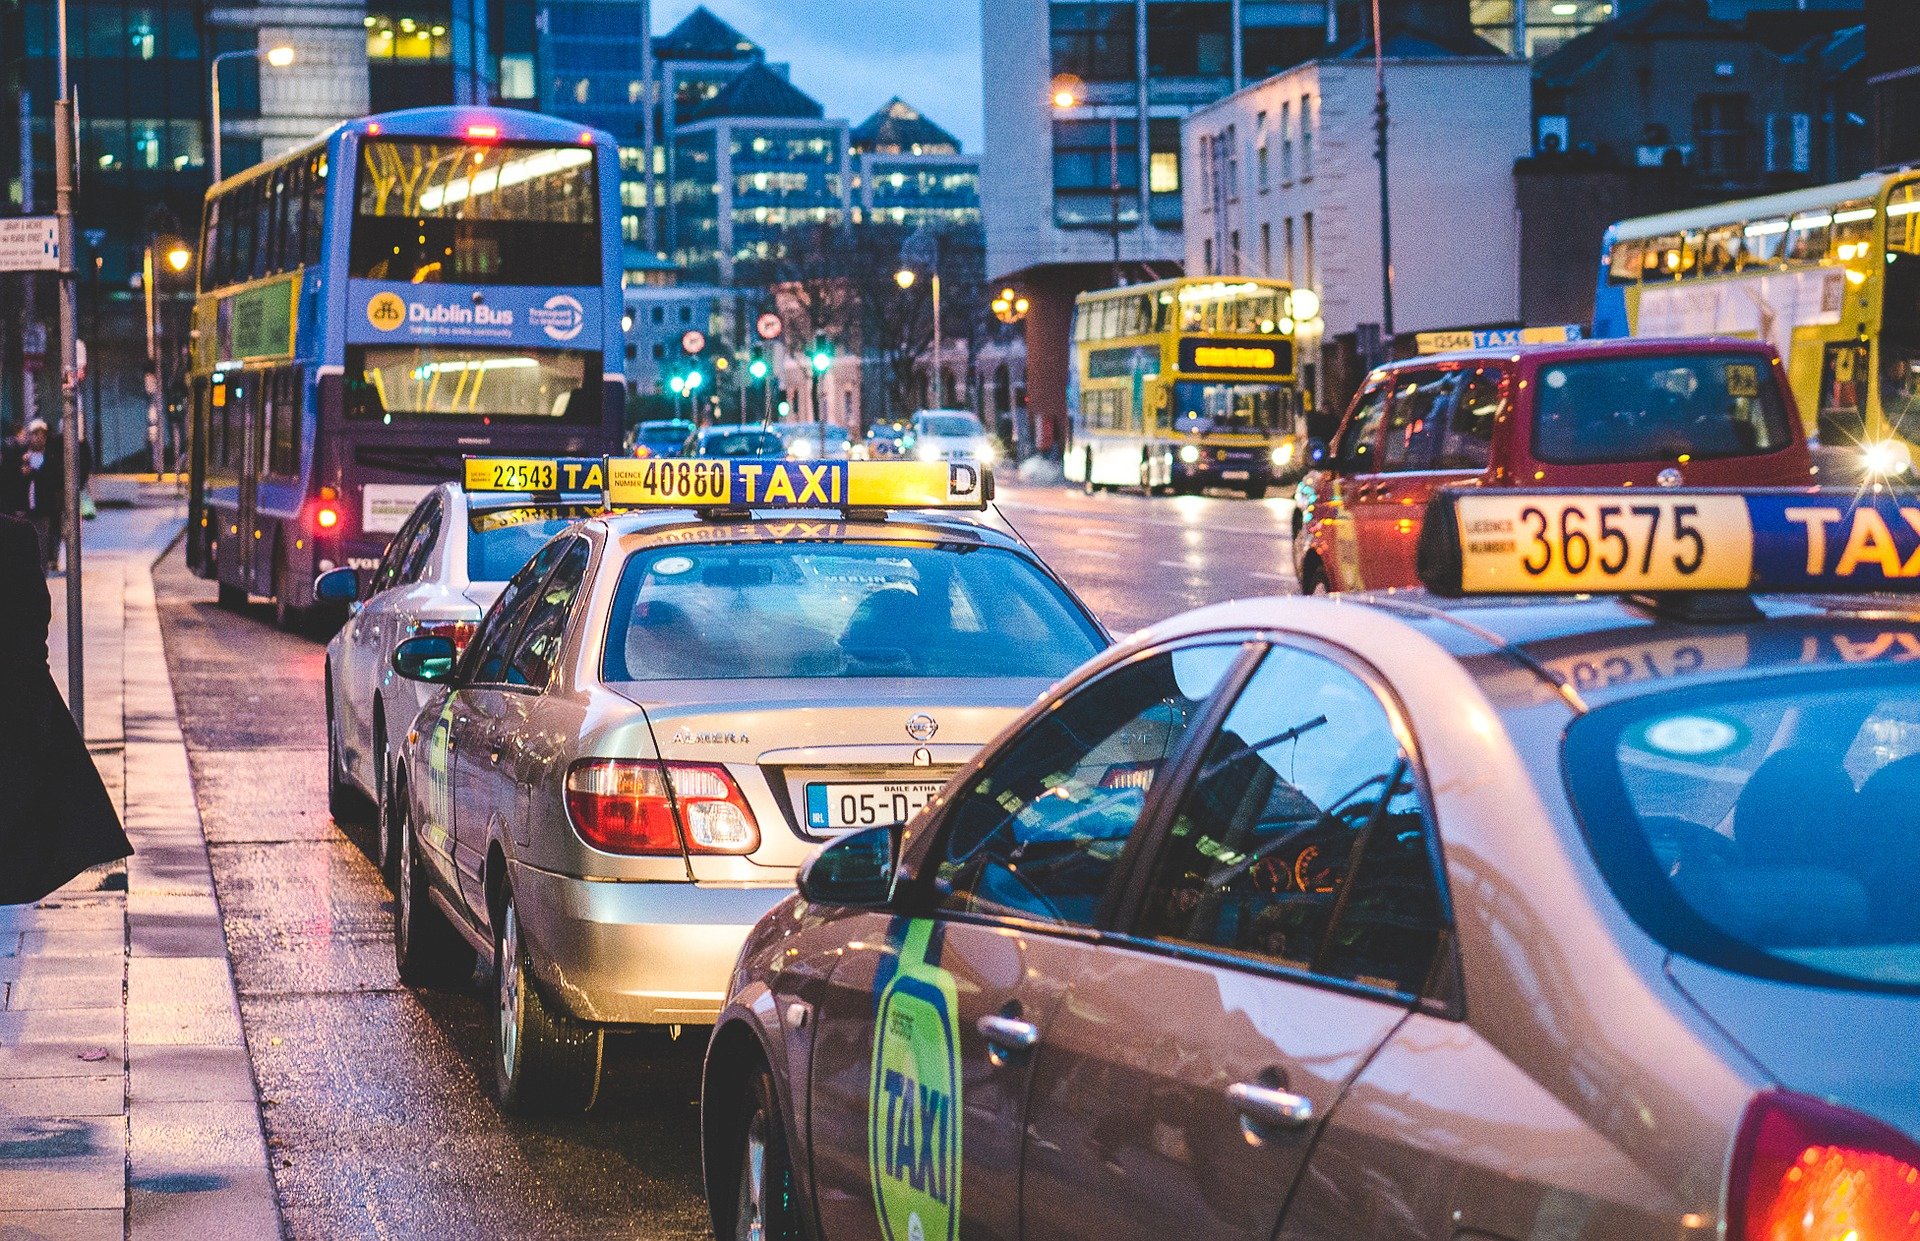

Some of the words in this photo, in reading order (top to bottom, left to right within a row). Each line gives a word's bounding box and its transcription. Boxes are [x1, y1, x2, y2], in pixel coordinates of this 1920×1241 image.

[409, 303, 472, 322] Dublin
[474, 304, 513, 325] Bus
[493, 465, 552, 489] 22543
[643, 462, 724, 498] 40880
[738, 465, 841, 504] TAXI
[949, 463, 978, 496] D
[1520, 506, 1705, 576] 36575
[673, 730, 750, 744] ALMERA
[841, 793, 935, 825] 05-D-
[884, 1068, 949, 1207] TAXI
